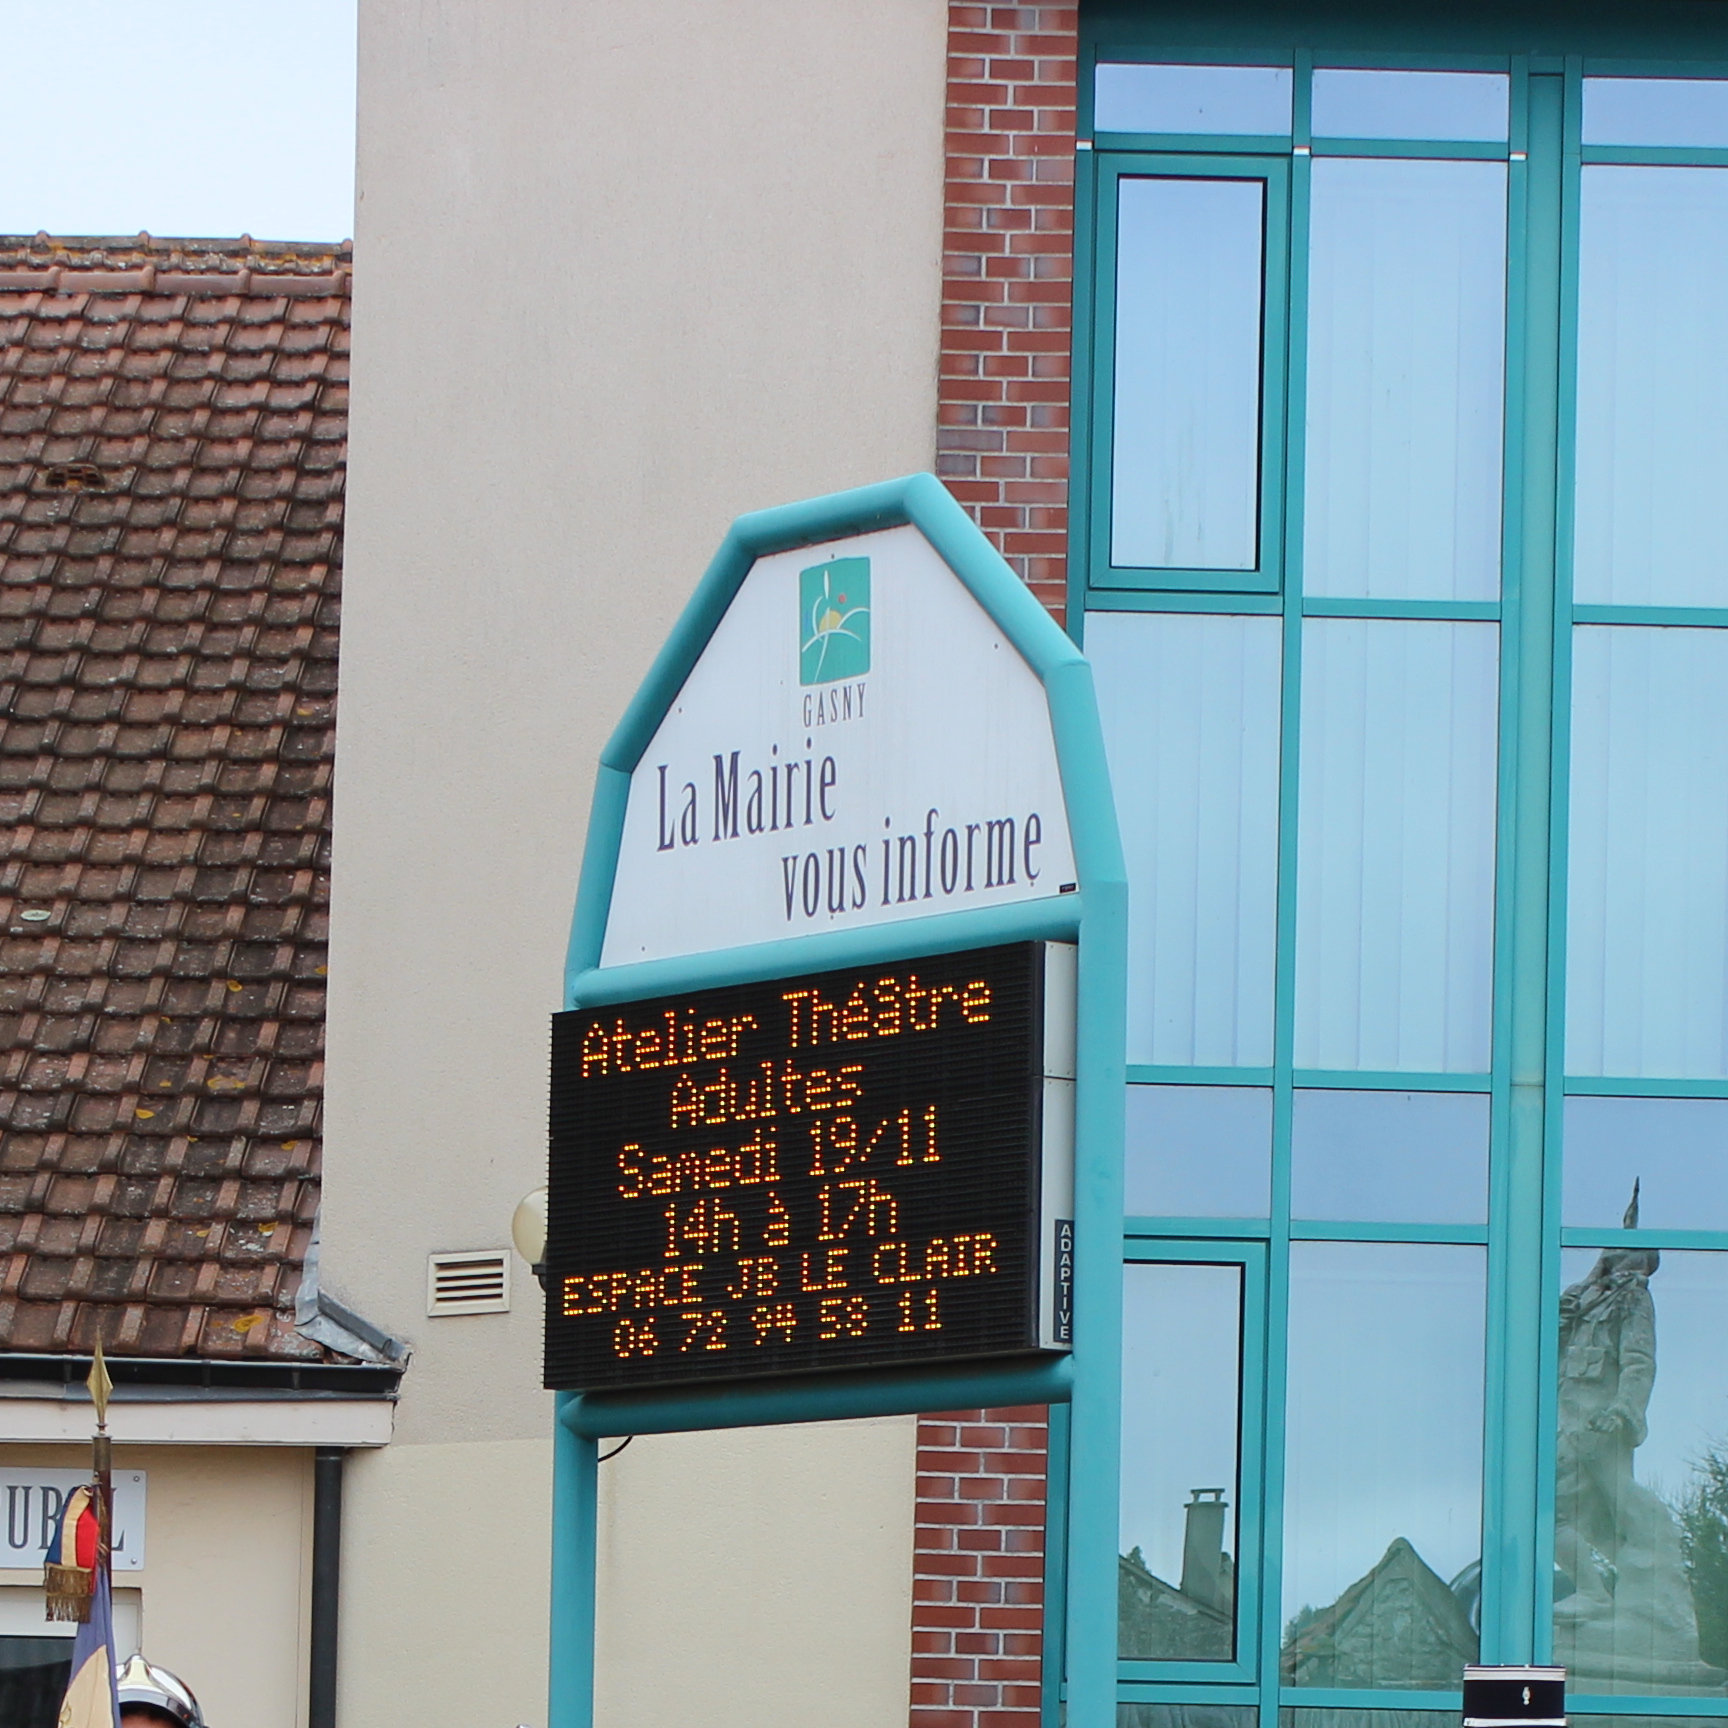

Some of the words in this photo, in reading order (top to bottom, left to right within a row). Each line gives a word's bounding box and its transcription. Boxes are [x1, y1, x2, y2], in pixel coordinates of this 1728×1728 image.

[803, 682, 867, 728] GASNY
[656, 764, 700, 852] La
[712, 736, 838, 842] Mairie
[781, 841, 868, 922] vous
[880, 807, 1042, 907] informe
[581, 1007, 759, 1078] Atelier
[781, 974, 992, 1048] Théâtre
[670, 1058, 865, 1129] Adultes
[617, 1125, 781, 1200] Samedi
[808, 1104, 942, 1176] 19/11
[664, 1198, 741, 1258] 14h
[763, 1190, 791, 1248] à
[817, 1178, 898, 1241] 17h
[562, 1263, 704, 1317] ESPACE
[726, 1255, 779, 1300] JB
[801, 1247, 850, 1292] LE
[873, 1231, 999, 1285] CLAIR
[1060, 1223, 1072, 1339] ADAPTIVE
[613, 1316, 661, 1359] 06
[680, 1310, 728, 1353] 72
[750, 1303, 799, 1347] 94
[897, 1289, 944, 1332] 11
